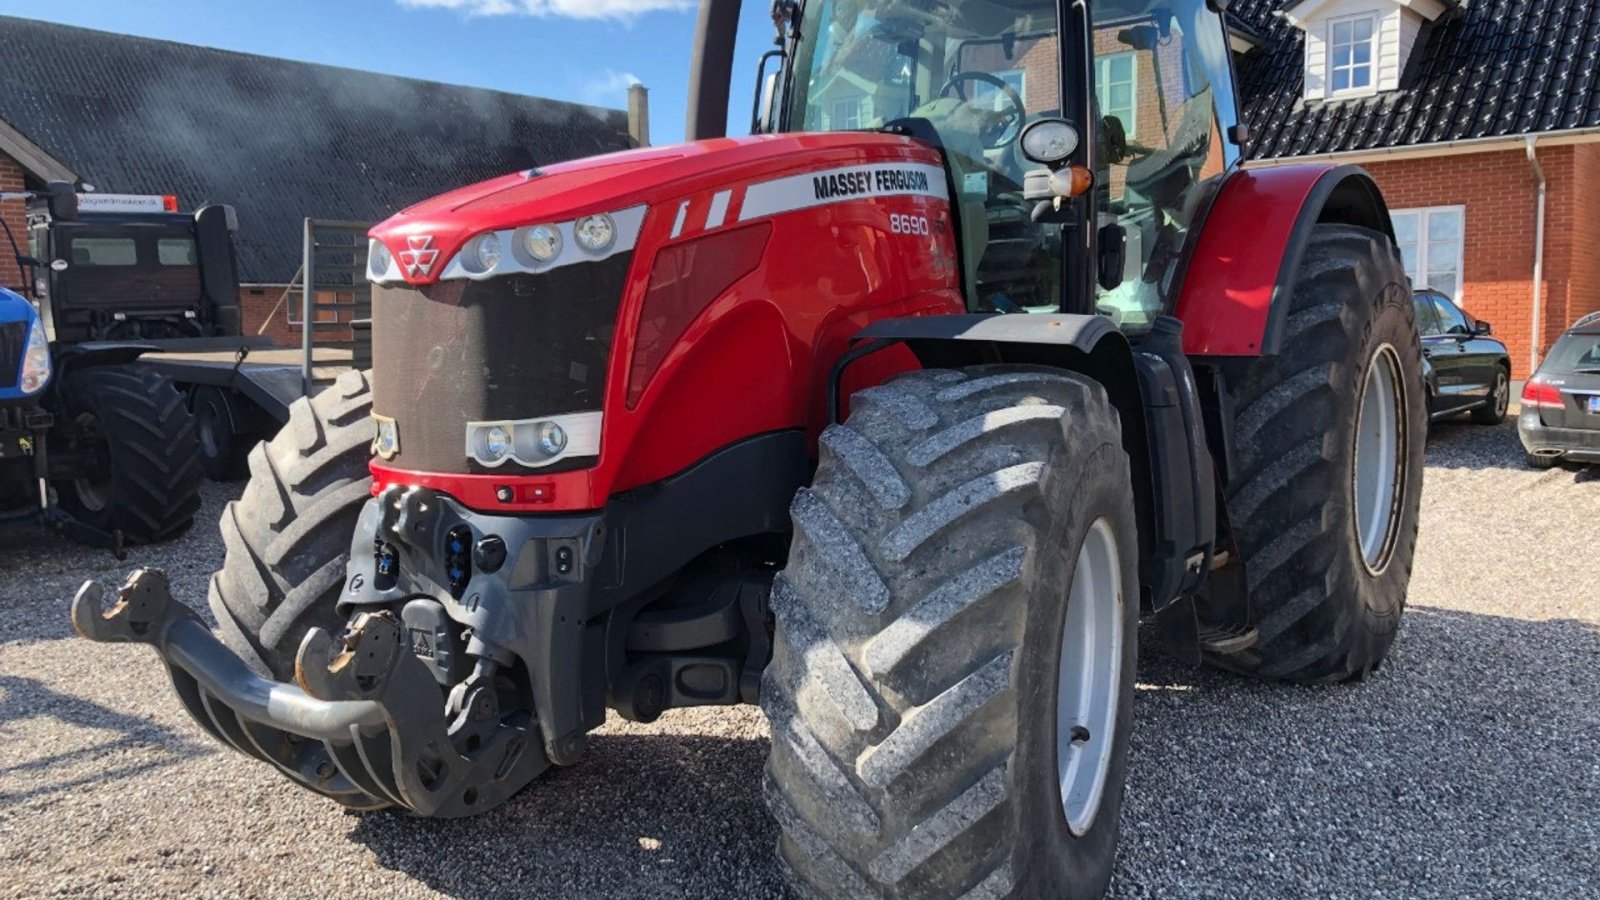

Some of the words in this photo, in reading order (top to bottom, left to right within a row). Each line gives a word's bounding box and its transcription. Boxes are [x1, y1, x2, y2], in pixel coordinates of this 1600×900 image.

[813, 171, 872, 199] MASSEY
[875, 170, 929, 192] FERGUSON
[890, 213, 929, 235] 8690
